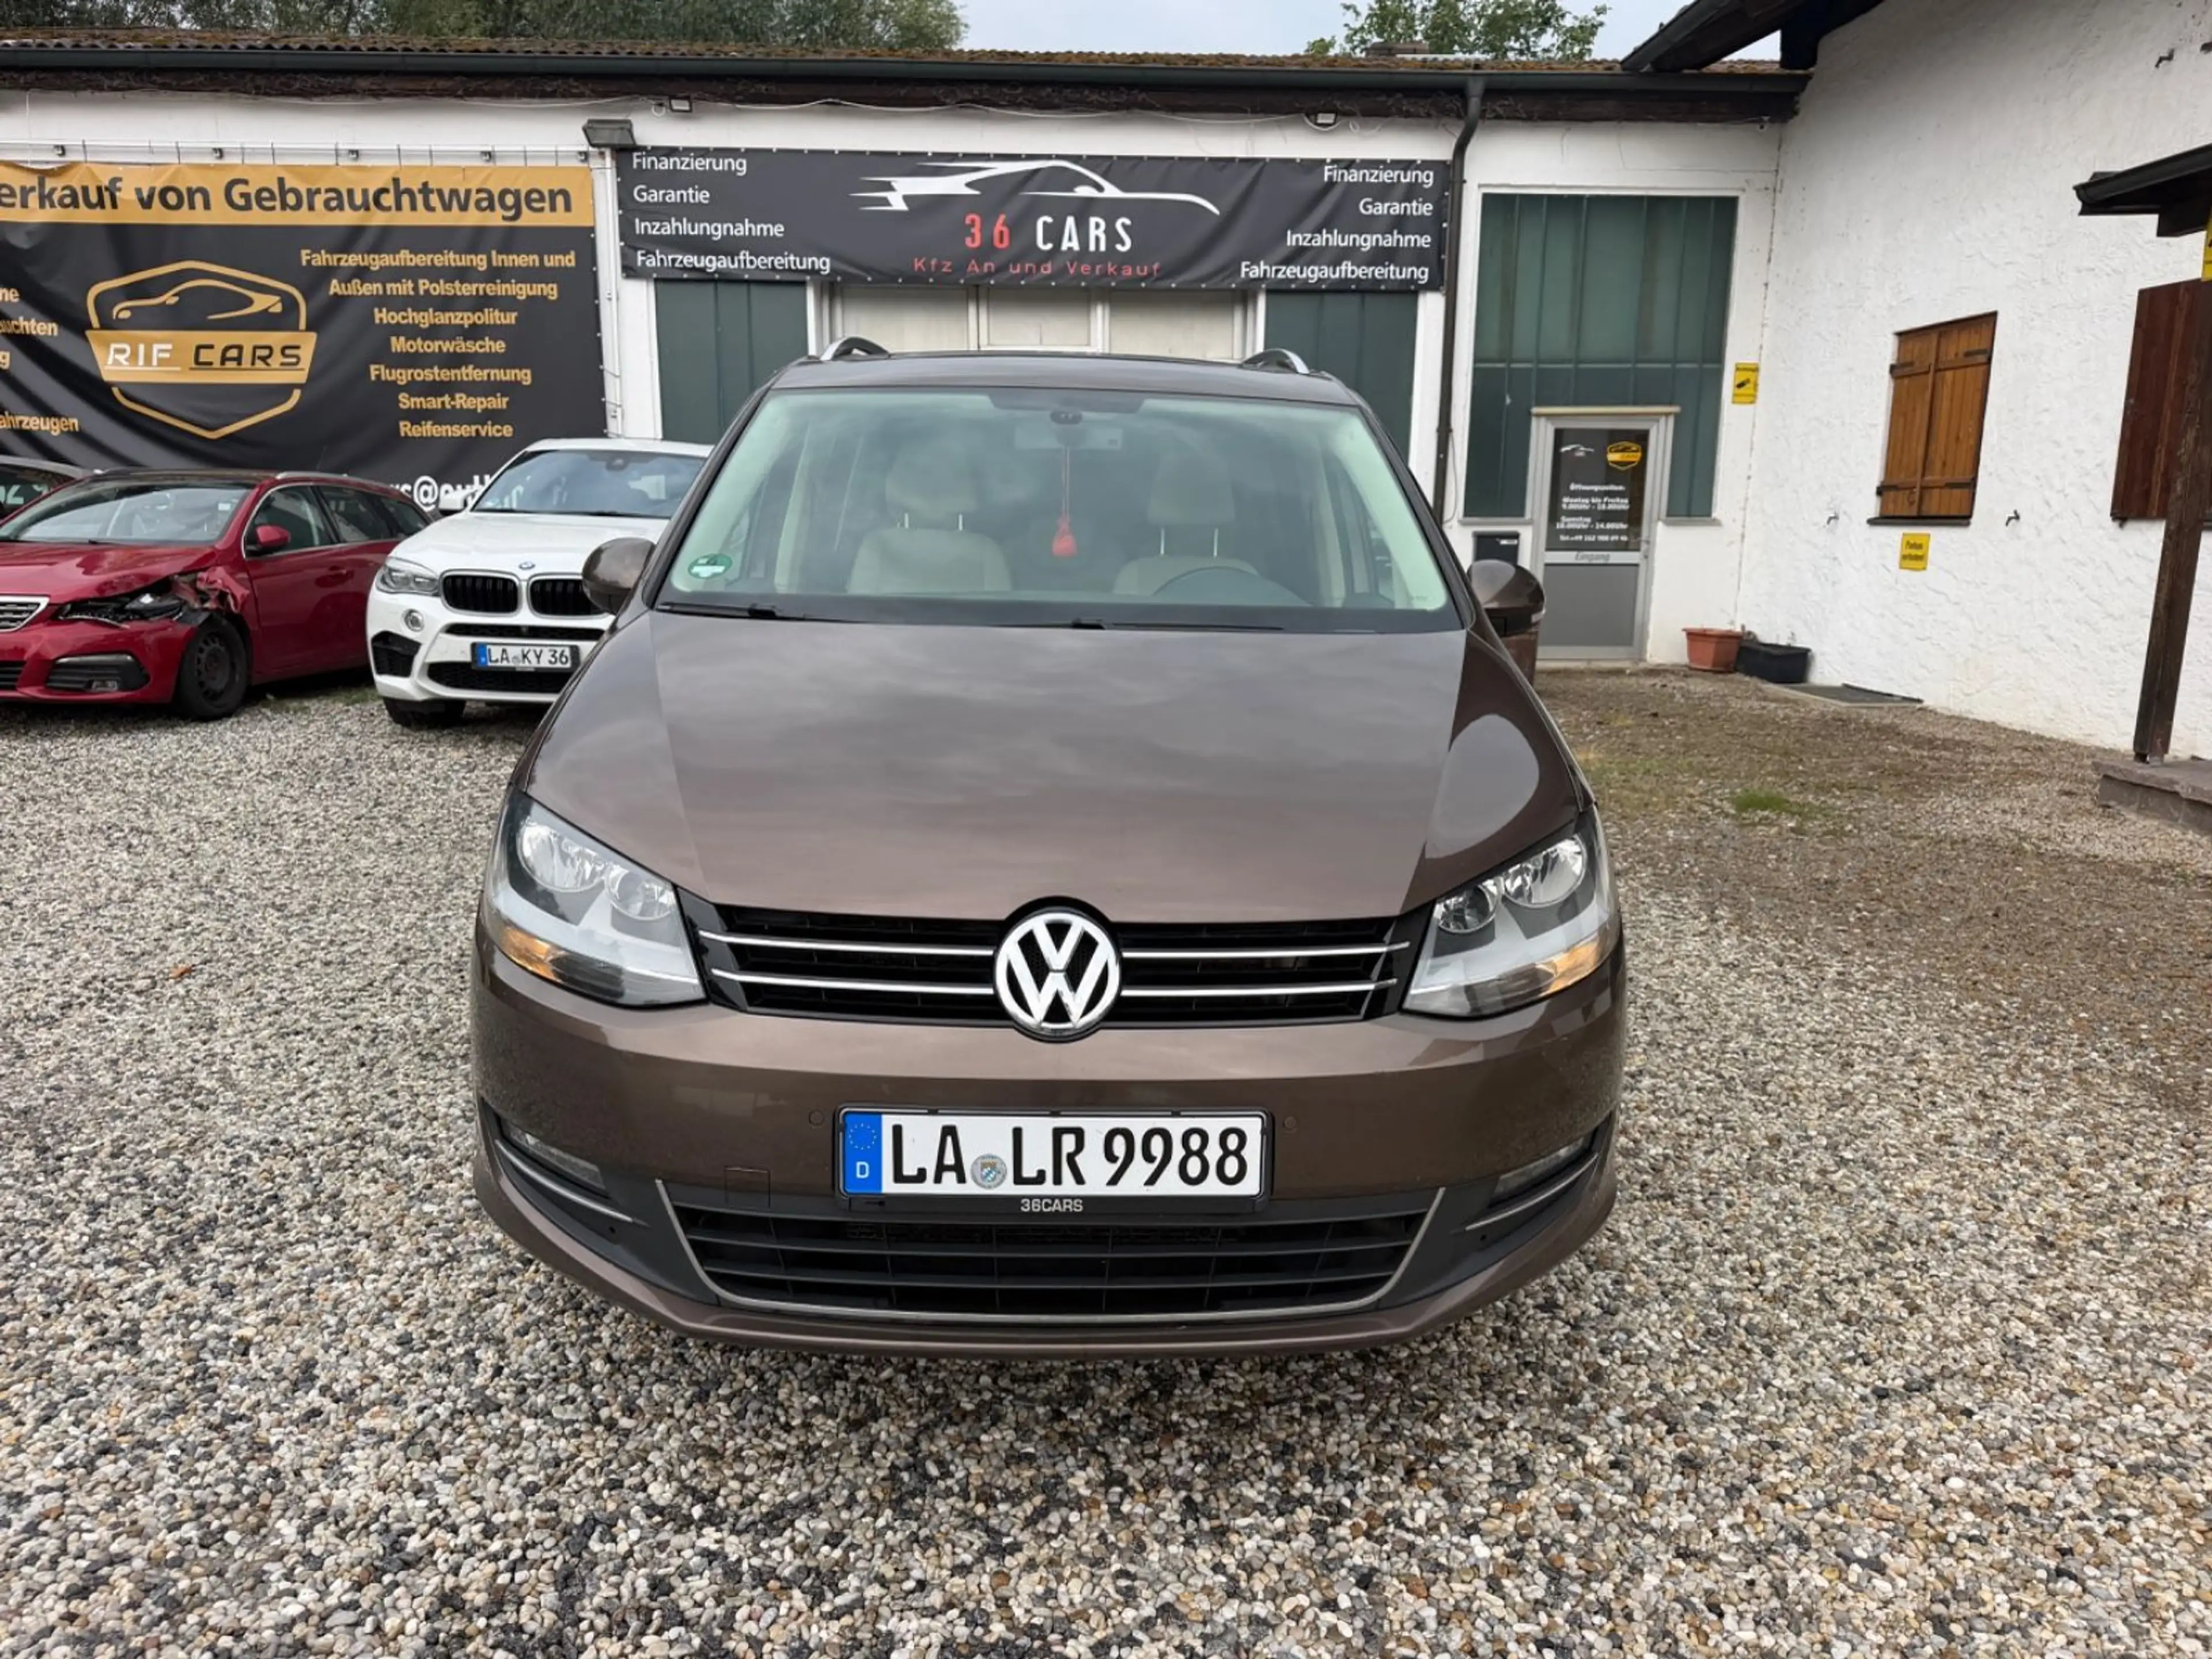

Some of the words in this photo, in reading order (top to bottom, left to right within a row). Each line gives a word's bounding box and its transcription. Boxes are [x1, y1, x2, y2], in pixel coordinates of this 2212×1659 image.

[632, 152, 747, 176] Finanzierung
[1324, 165, 1434, 188] Finanzierung
[135, 185, 211, 210] von
[224, 176, 572, 221] Gebrauchtwagen
[634, 185, 710, 203] Garantie
[1359, 198, 1433, 215] Garantie
[635, 217, 785, 240] Inzahlungnahme
[964, 213, 1010, 249] 36
[1036, 215, 1132, 252] CARS
[1287, 229, 1431, 251] Inzahlungnahme
[300, 249, 487, 271] Fahrzeugaufbereitung
[491, 249, 539, 267] Innen
[544, 250, 575, 267] und
[637, 250, 831, 274] Fahrzeugaufbereitung
[914, 257, 952, 272] Kfz
[967, 259, 995, 272] An
[1009, 260, 1052, 274] und
[1067, 261, 1161, 276] Verkauf
[1240, 261, 1429, 284] Fahrzeugaufbereitung
[329, 279, 382, 296] Außen
[386, 279, 414, 296] mit
[418, 279, 558, 300] Polsterreinigung
[374, 308, 517, 328] Hochglanzpolitur
[107, 343, 172, 366] RIF
[194, 344, 301, 366] CARS
[390, 336, 506, 353] Motorwäsche
[369, 364, 532, 385] Flugrostentfernung
[398, 393, 509, 412] Smart-Repair
[399, 421, 513, 437] Reifenservice
[488, 648, 510, 664] LA
[521, 648, 543, 665] KY
[548, 649, 569, 665] 36
[892, 1124, 966, 1185] LA
[1012, 1126, 1086, 1186] LR
[1103, 1127, 1248, 1187] 9988
[856, 1161, 869, 1179] D
[1021, 1198, 1083, 1212] 36CARS
